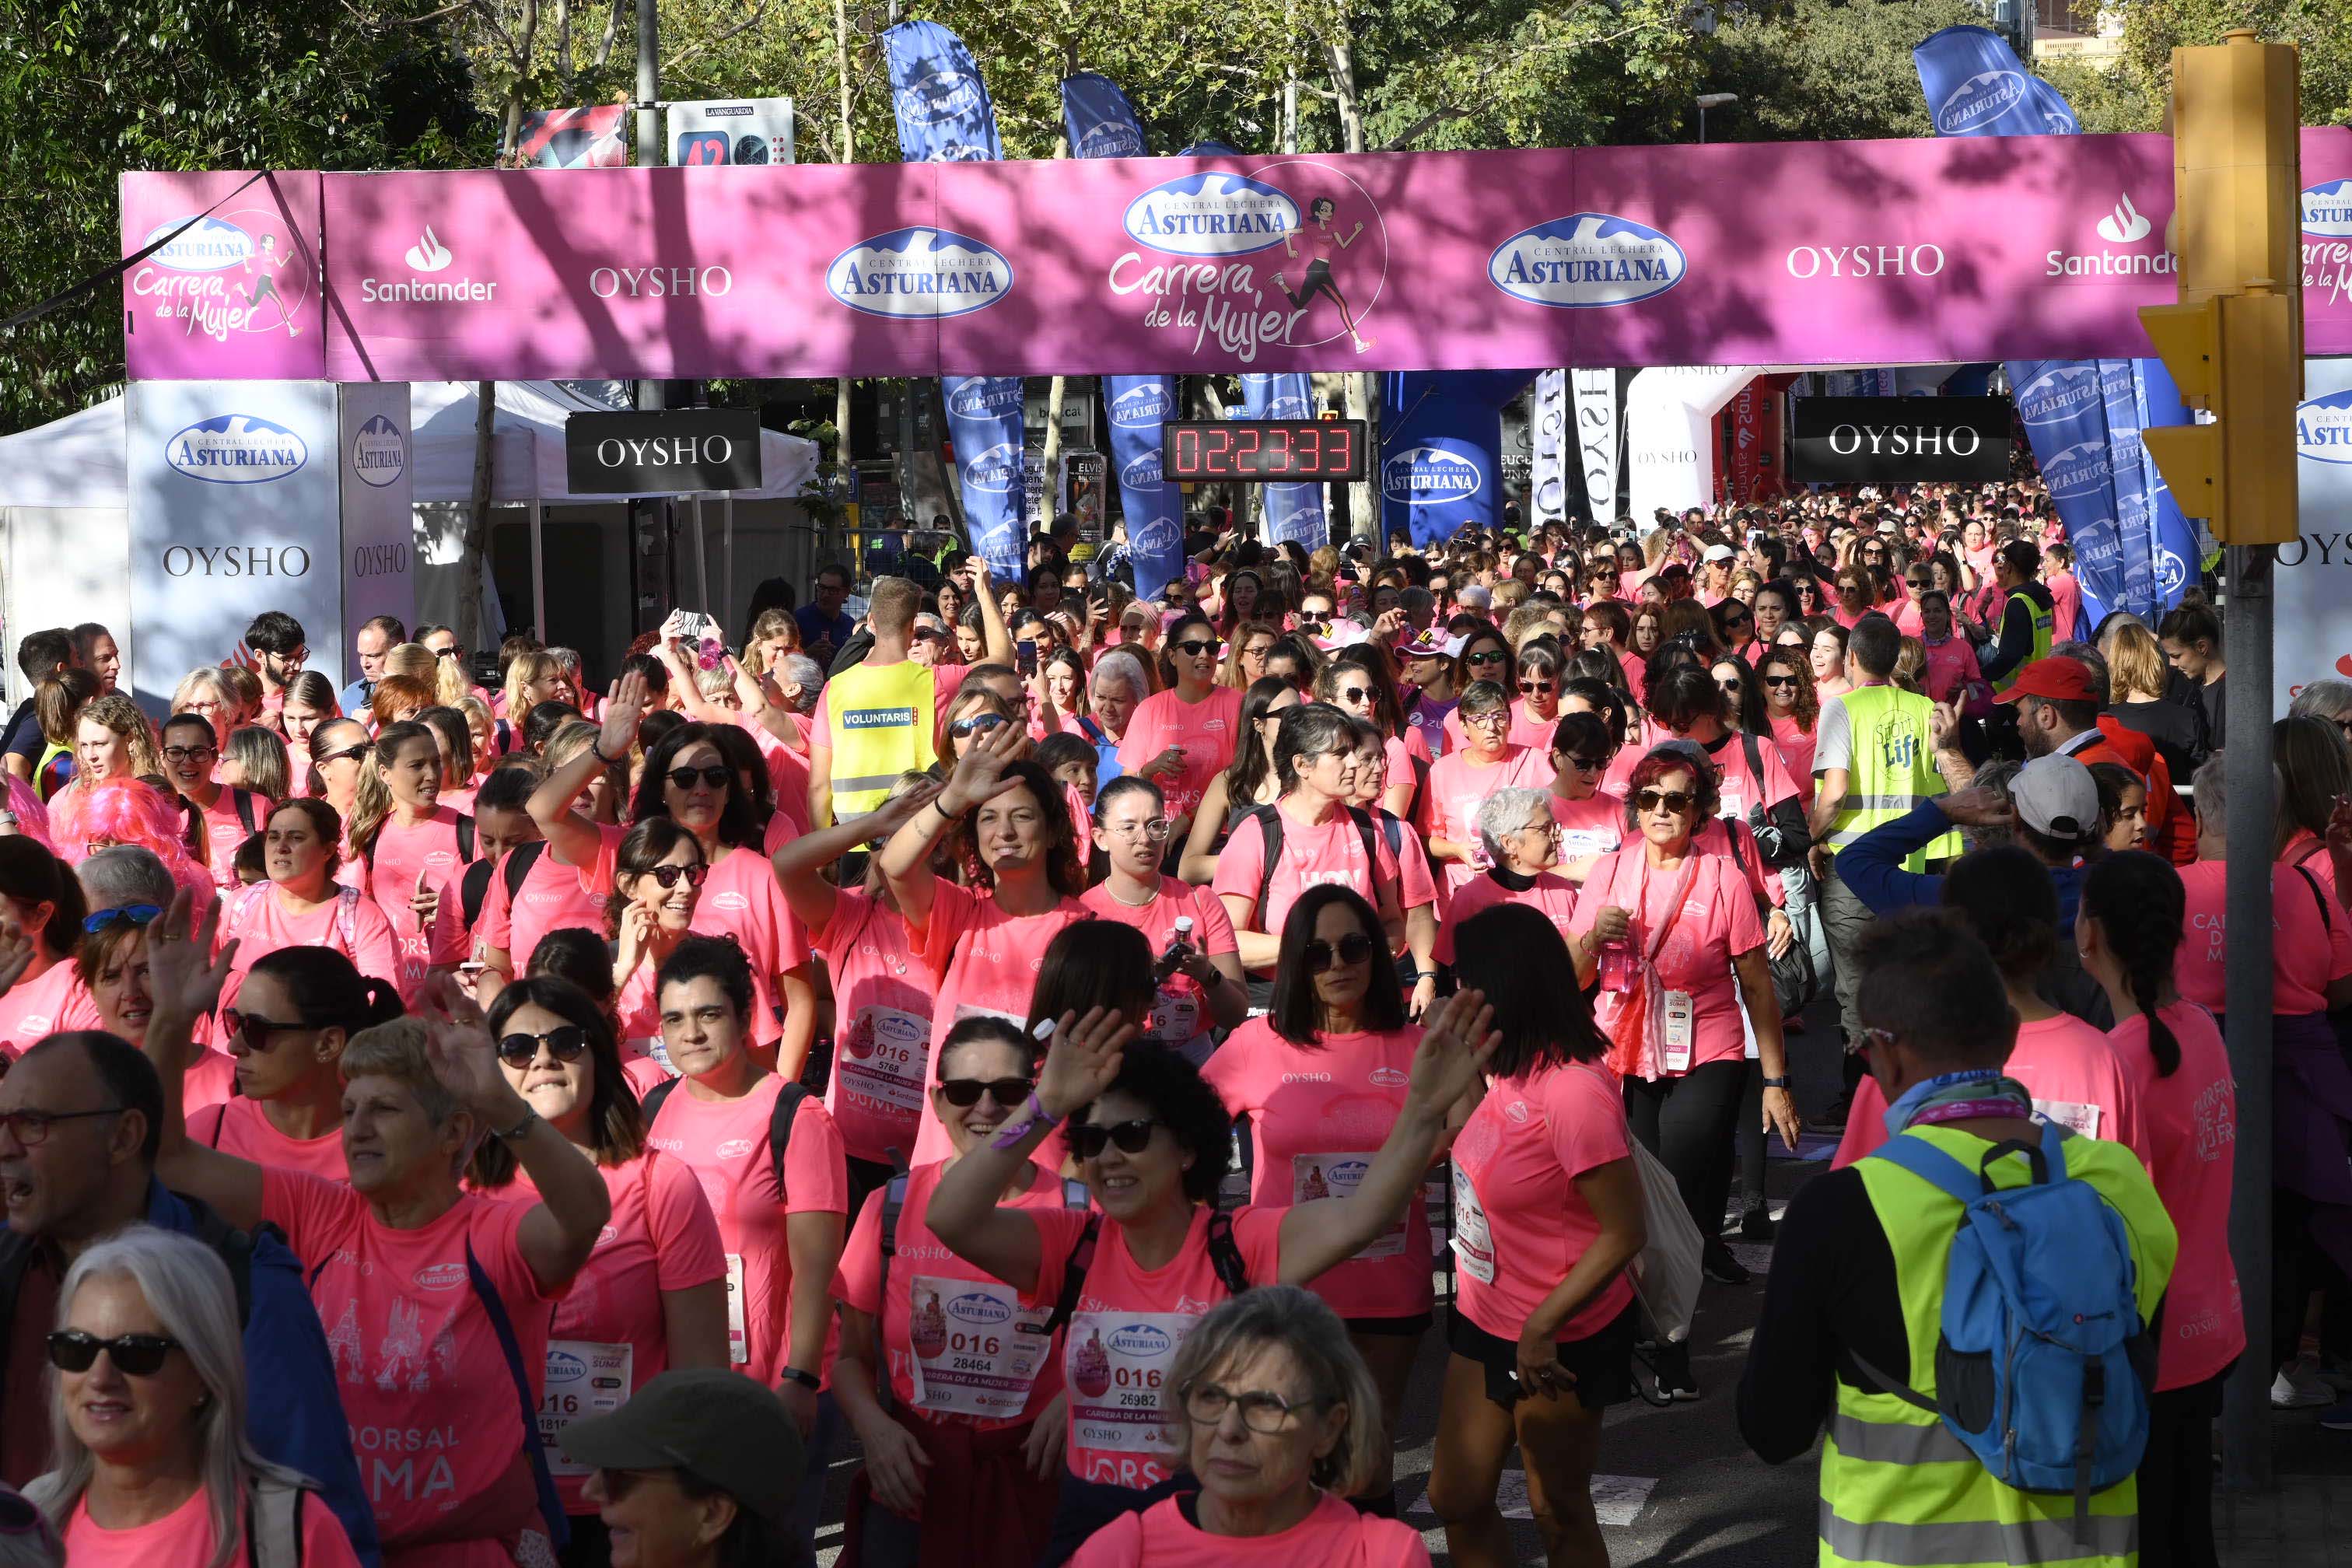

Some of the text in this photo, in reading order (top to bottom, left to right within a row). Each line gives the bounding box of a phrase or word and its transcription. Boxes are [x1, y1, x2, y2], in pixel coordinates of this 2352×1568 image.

[1164, 200, 1283, 210] CENTRAL LECHERA
[1137, 204, 1286, 235] ASTURIANA
[1534, 244, 1664, 257] CENTRAL LECHERA
[1787, 243, 1944, 279] OYSHO
[841, 261, 999, 296] ASTURIANA
[1108, 251, 1255, 296] Carrera
[1503, 250, 1671, 285] ASTURIANA
[2318, 264, 2333, 286] la
[133, 267, 226, 297] Carrera
[362, 277, 497, 303] Santander
[589, 265, 732, 299] OYSHO
[156, 292, 261, 342] de la Mujer
[1144, 289, 1309, 363] de la Mujer
[176, 440, 297, 466] ASTURIANA
[357, 441, 401, 469] ASTURIANA
[597, 436, 732, 467] OYSHO
[1177, 429, 1349, 472] 02:23:33
[1829, 424, 1979, 464] OYSHO
[1079, 463, 1102, 472] ELVIS
[1386, 471, 1473, 492] ASTURIANA
[163, 546, 310, 576] OYSHO
[355, 543, 406, 577] OYSHO
[845, 712, 910, 724] VOLUNTARIS
[1883, 734, 1920, 768] Life
[880, 1022, 917, 1038] ASTURIANA
[877, 1044, 909, 1062] 016
[879, 1061, 899, 1073] 5768
[1283, 1073, 1331, 1083] OYSHO
[844, 1076, 874, 1090] OYSHO
[1456, 1202, 1470, 1226] 016
[898, 1244, 954, 1260] OYSHO
[952, 1301, 1006, 1319] ASTURIANA
[2180, 1318, 2221, 1339] OYSHO
[951, 1333, 999, 1355] 016
[1112, 1335, 1166, 1349] ASTURIANA
[954, 1357, 992, 1372] 28464
[981, 1378, 1009, 1388] MUJER
[1115, 1367, 1161, 1388] 016
[1120, 1393, 1156, 1406] 26982
[1086, 1409, 1122, 1419] CARRERA
[1083, 1428, 1122, 1440] OYSHO
[355, 1455, 456, 1502] MA
